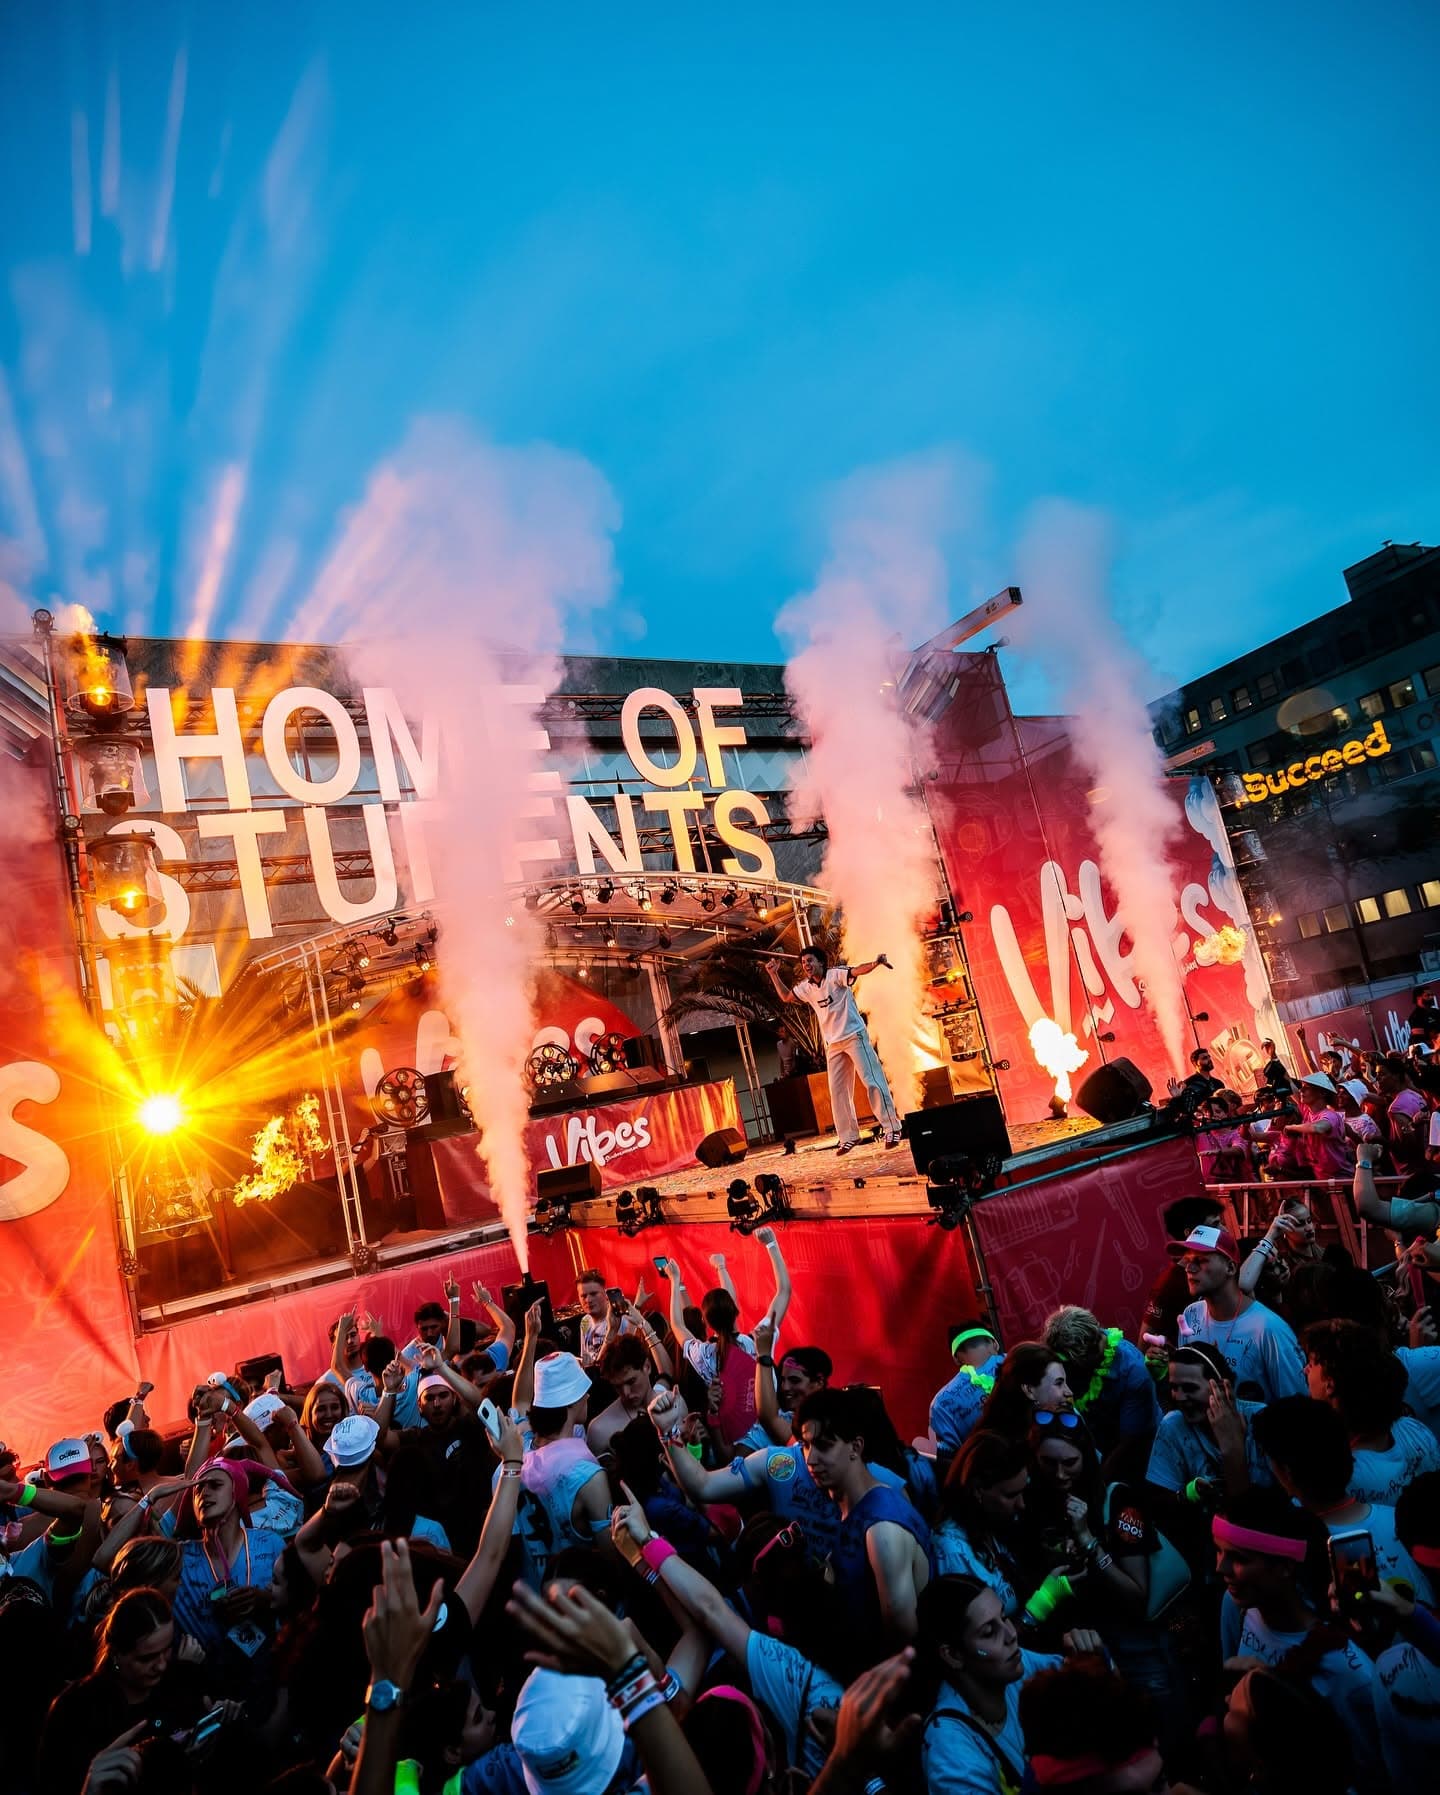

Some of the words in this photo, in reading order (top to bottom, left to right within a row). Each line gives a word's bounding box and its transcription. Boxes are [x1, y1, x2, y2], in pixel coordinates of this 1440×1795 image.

[146, 685, 562, 813] HOME
[621, 687, 747, 788] OF
[1242, 720, 1391, 803] Succeed
[546, 1116, 651, 1168] Vibes
